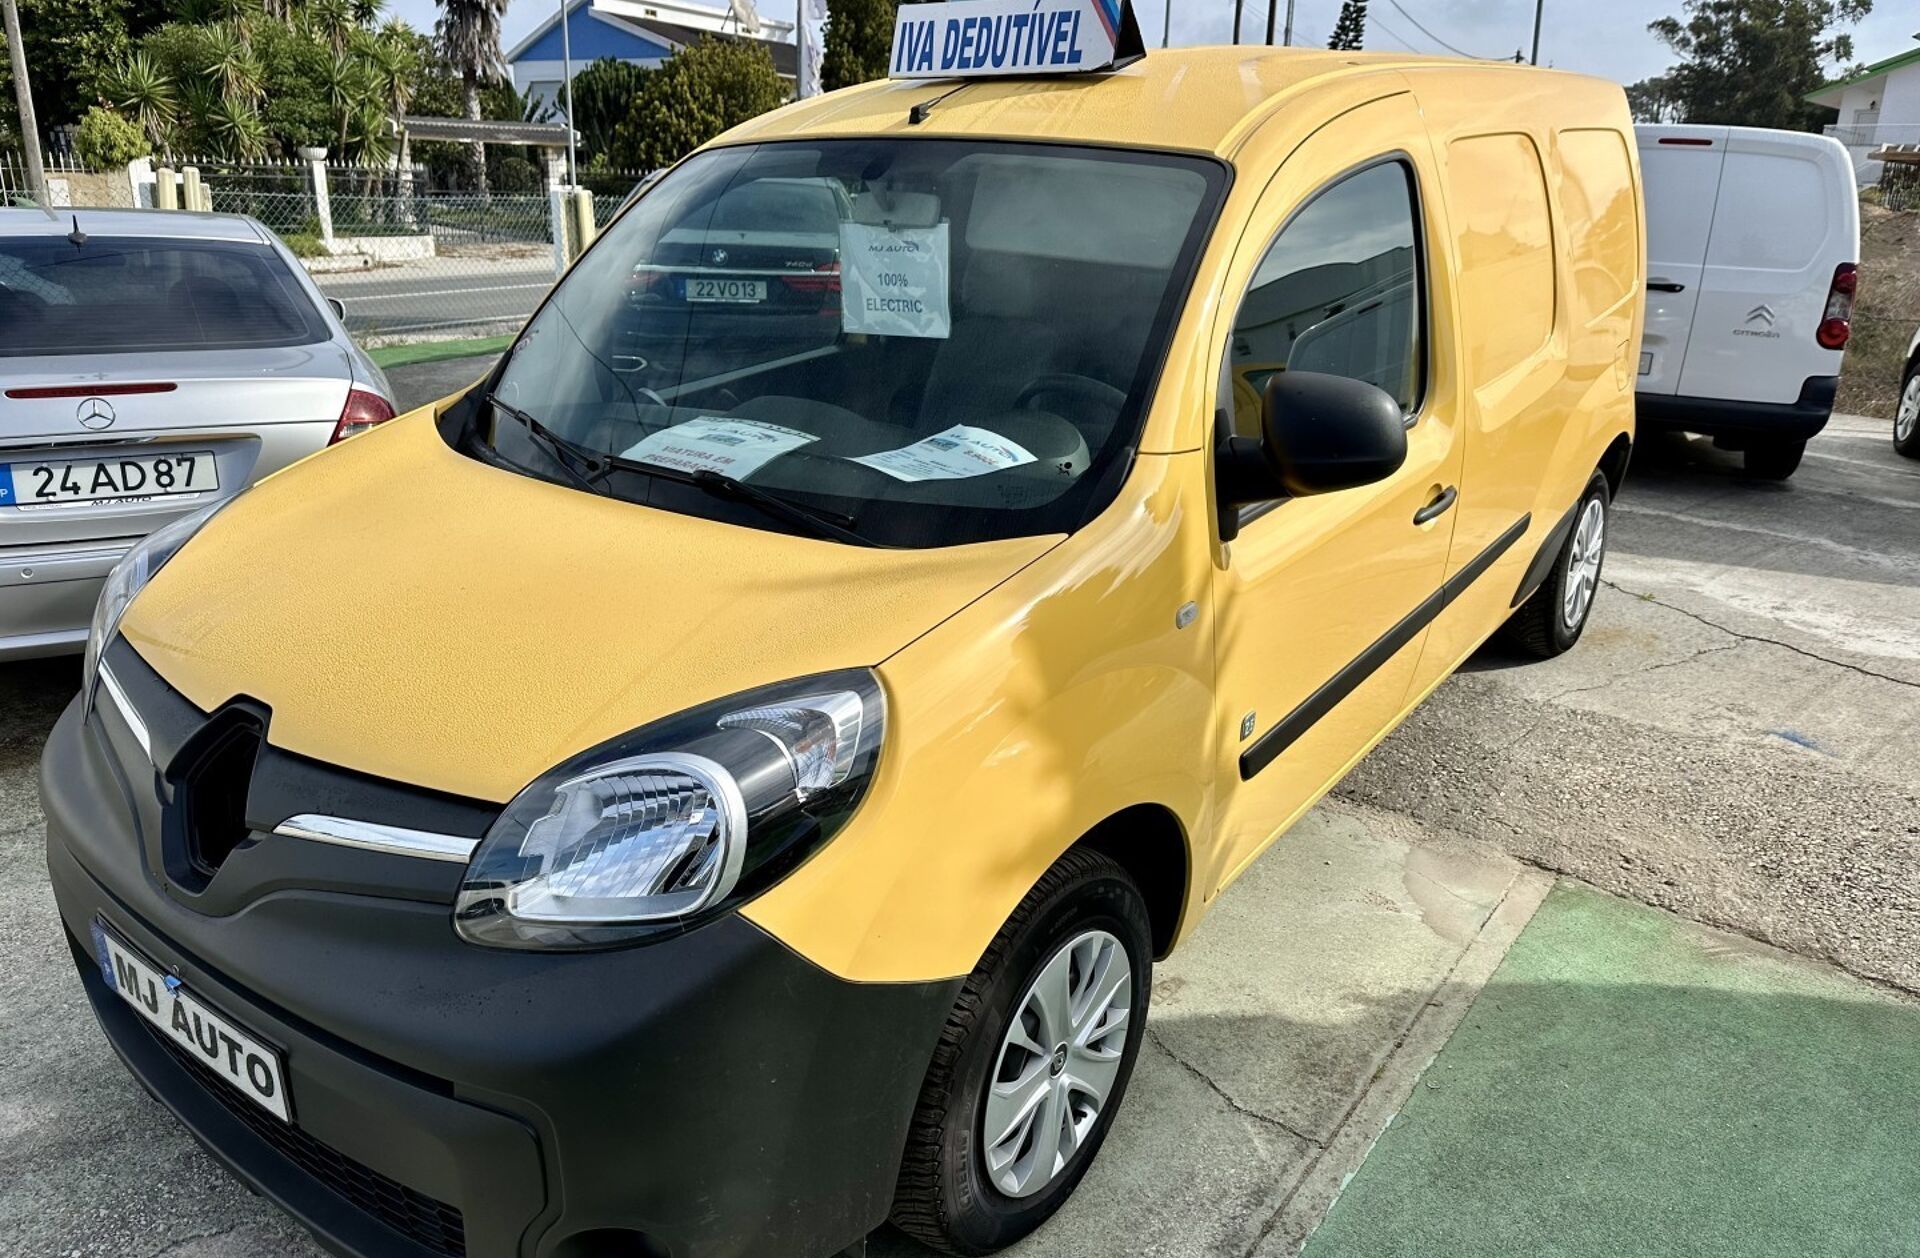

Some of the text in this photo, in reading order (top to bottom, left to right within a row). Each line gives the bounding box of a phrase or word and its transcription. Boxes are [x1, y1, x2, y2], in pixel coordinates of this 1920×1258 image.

[895, 0, 1083, 73] IVA DEDUTÍVEL
[877, 272, 909, 287] 100%
[866, 298, 923, 313] ELECTRIC
[114, 952, 275, 1098] MJ AUTO
